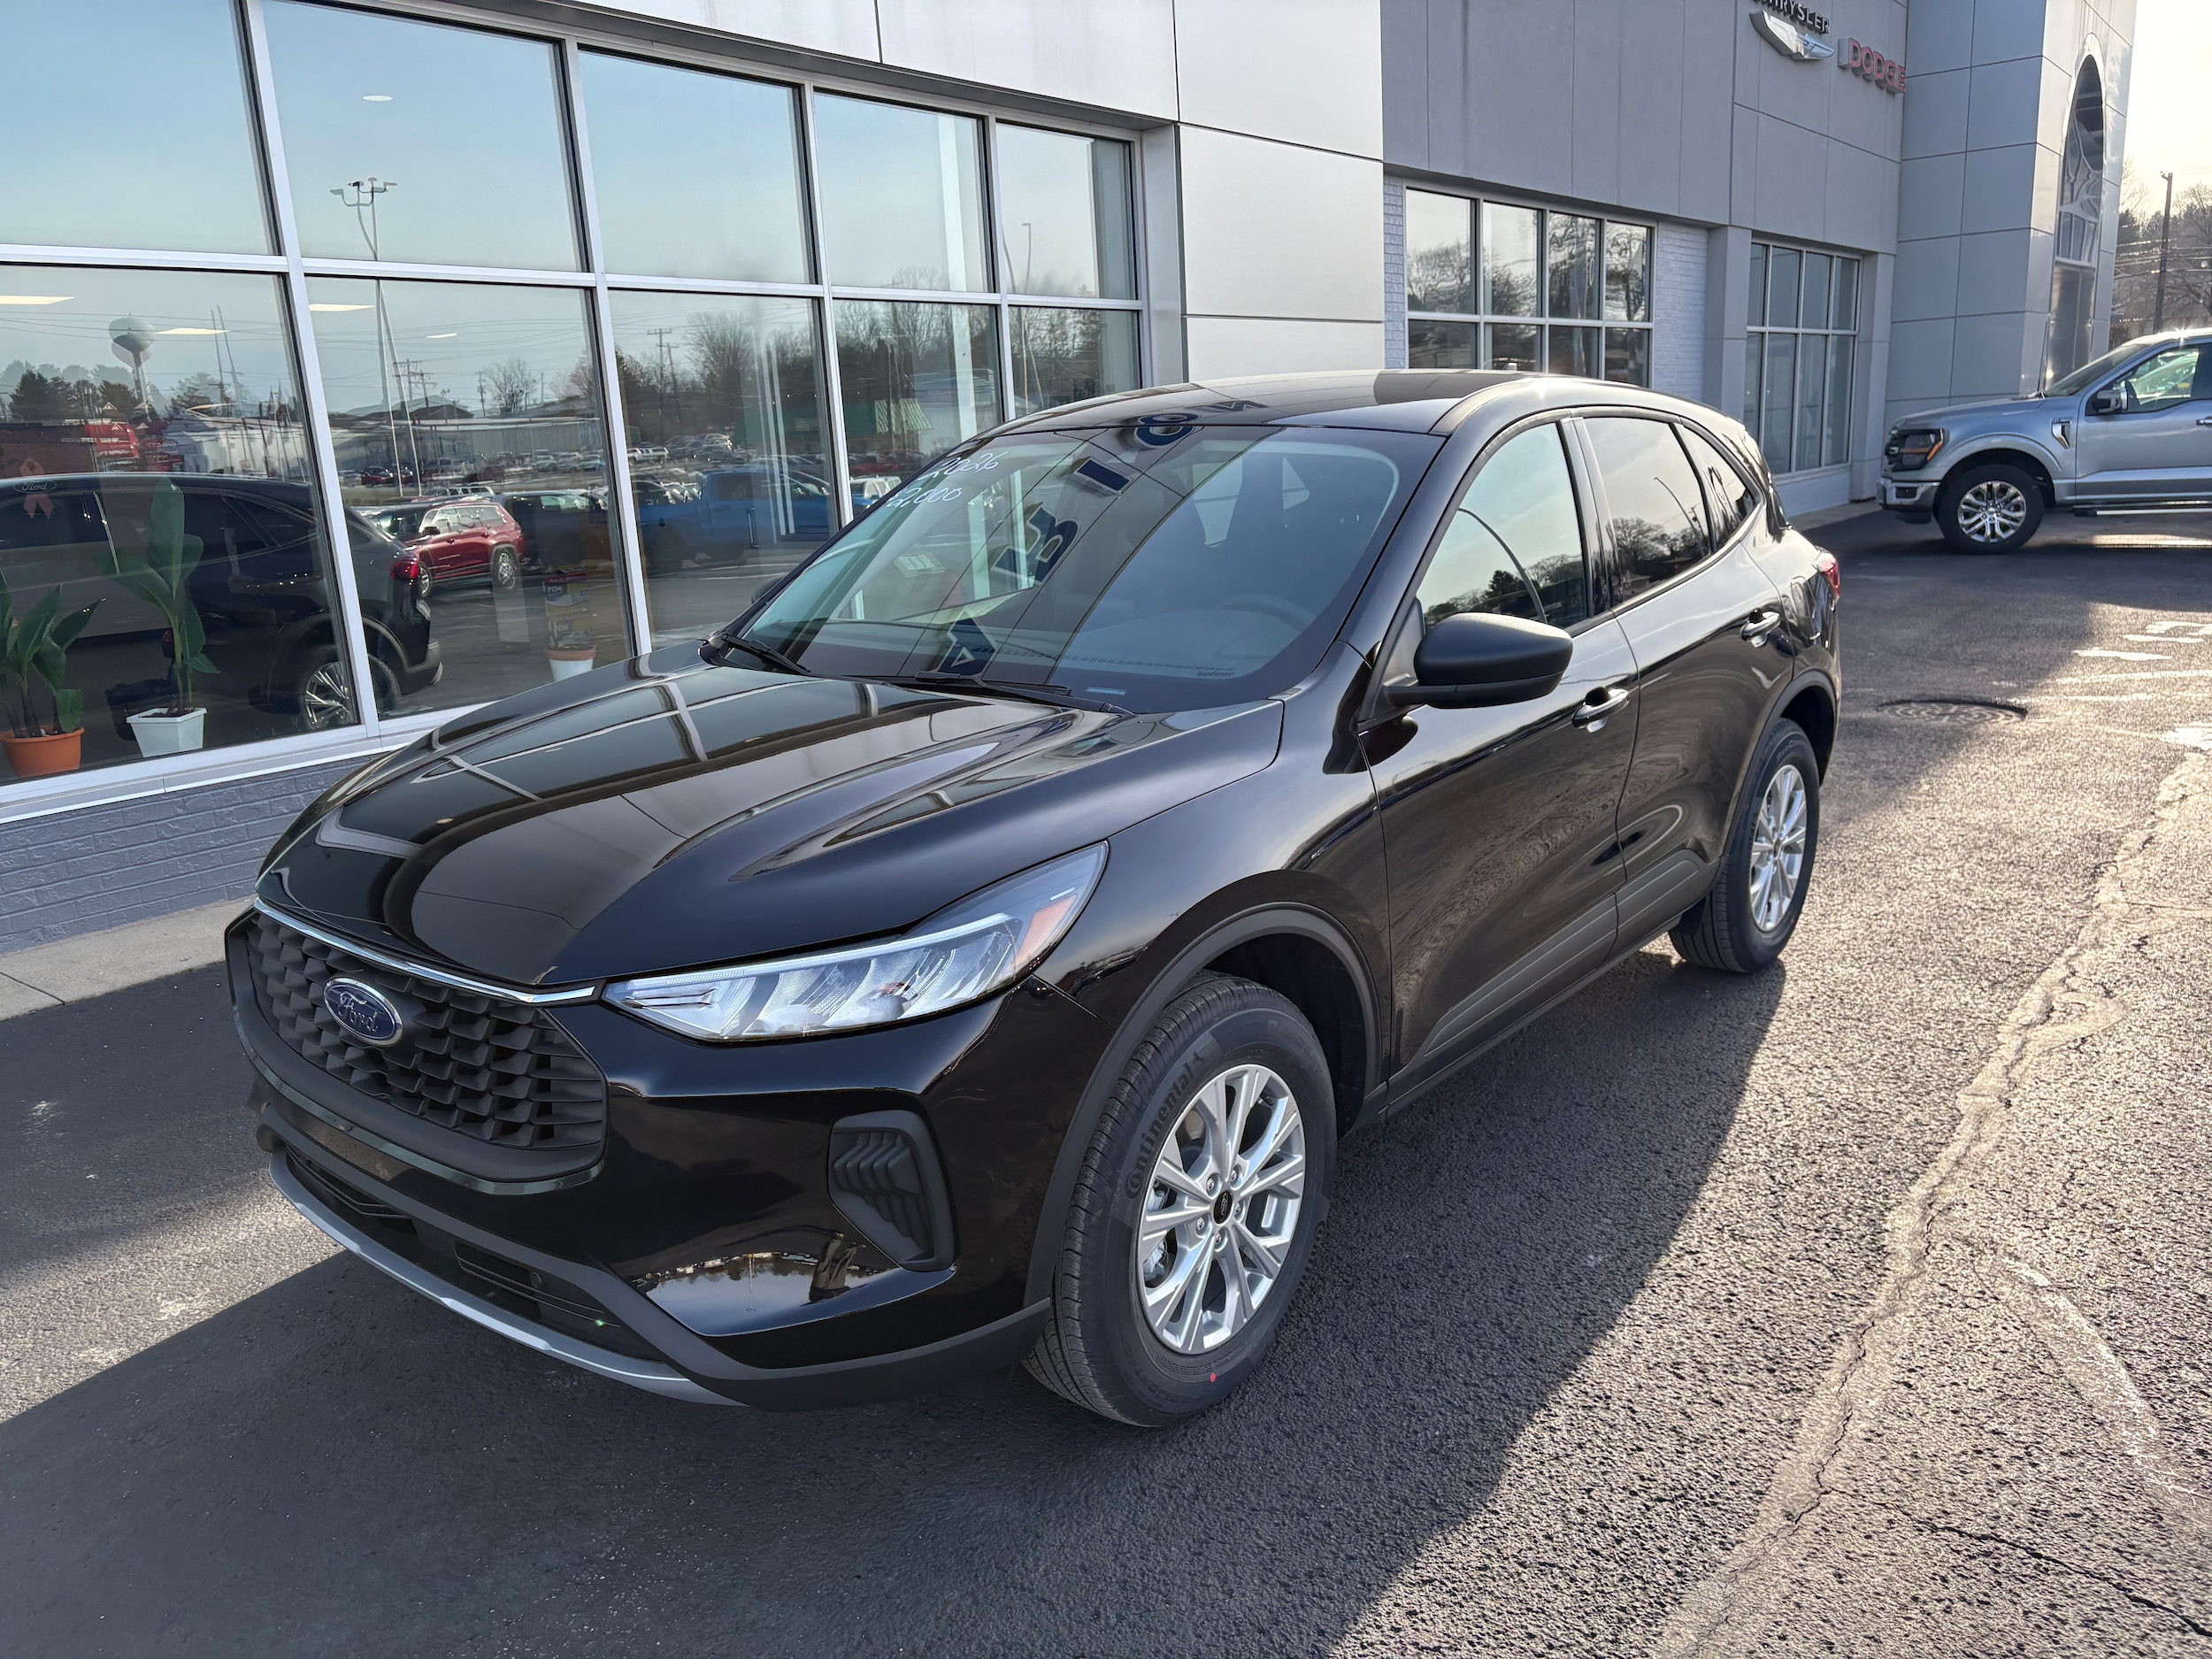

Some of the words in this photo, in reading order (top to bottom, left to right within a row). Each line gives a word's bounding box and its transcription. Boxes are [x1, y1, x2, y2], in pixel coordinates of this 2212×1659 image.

[1847, 38, 1906, 93] DODGE
[21, 480, 49, 491] Ford
[918, 452, 1009, 481] 2026
[337, 990, 379, 1033] Ford
[1125, 1064, 1195, 1199] Continental
